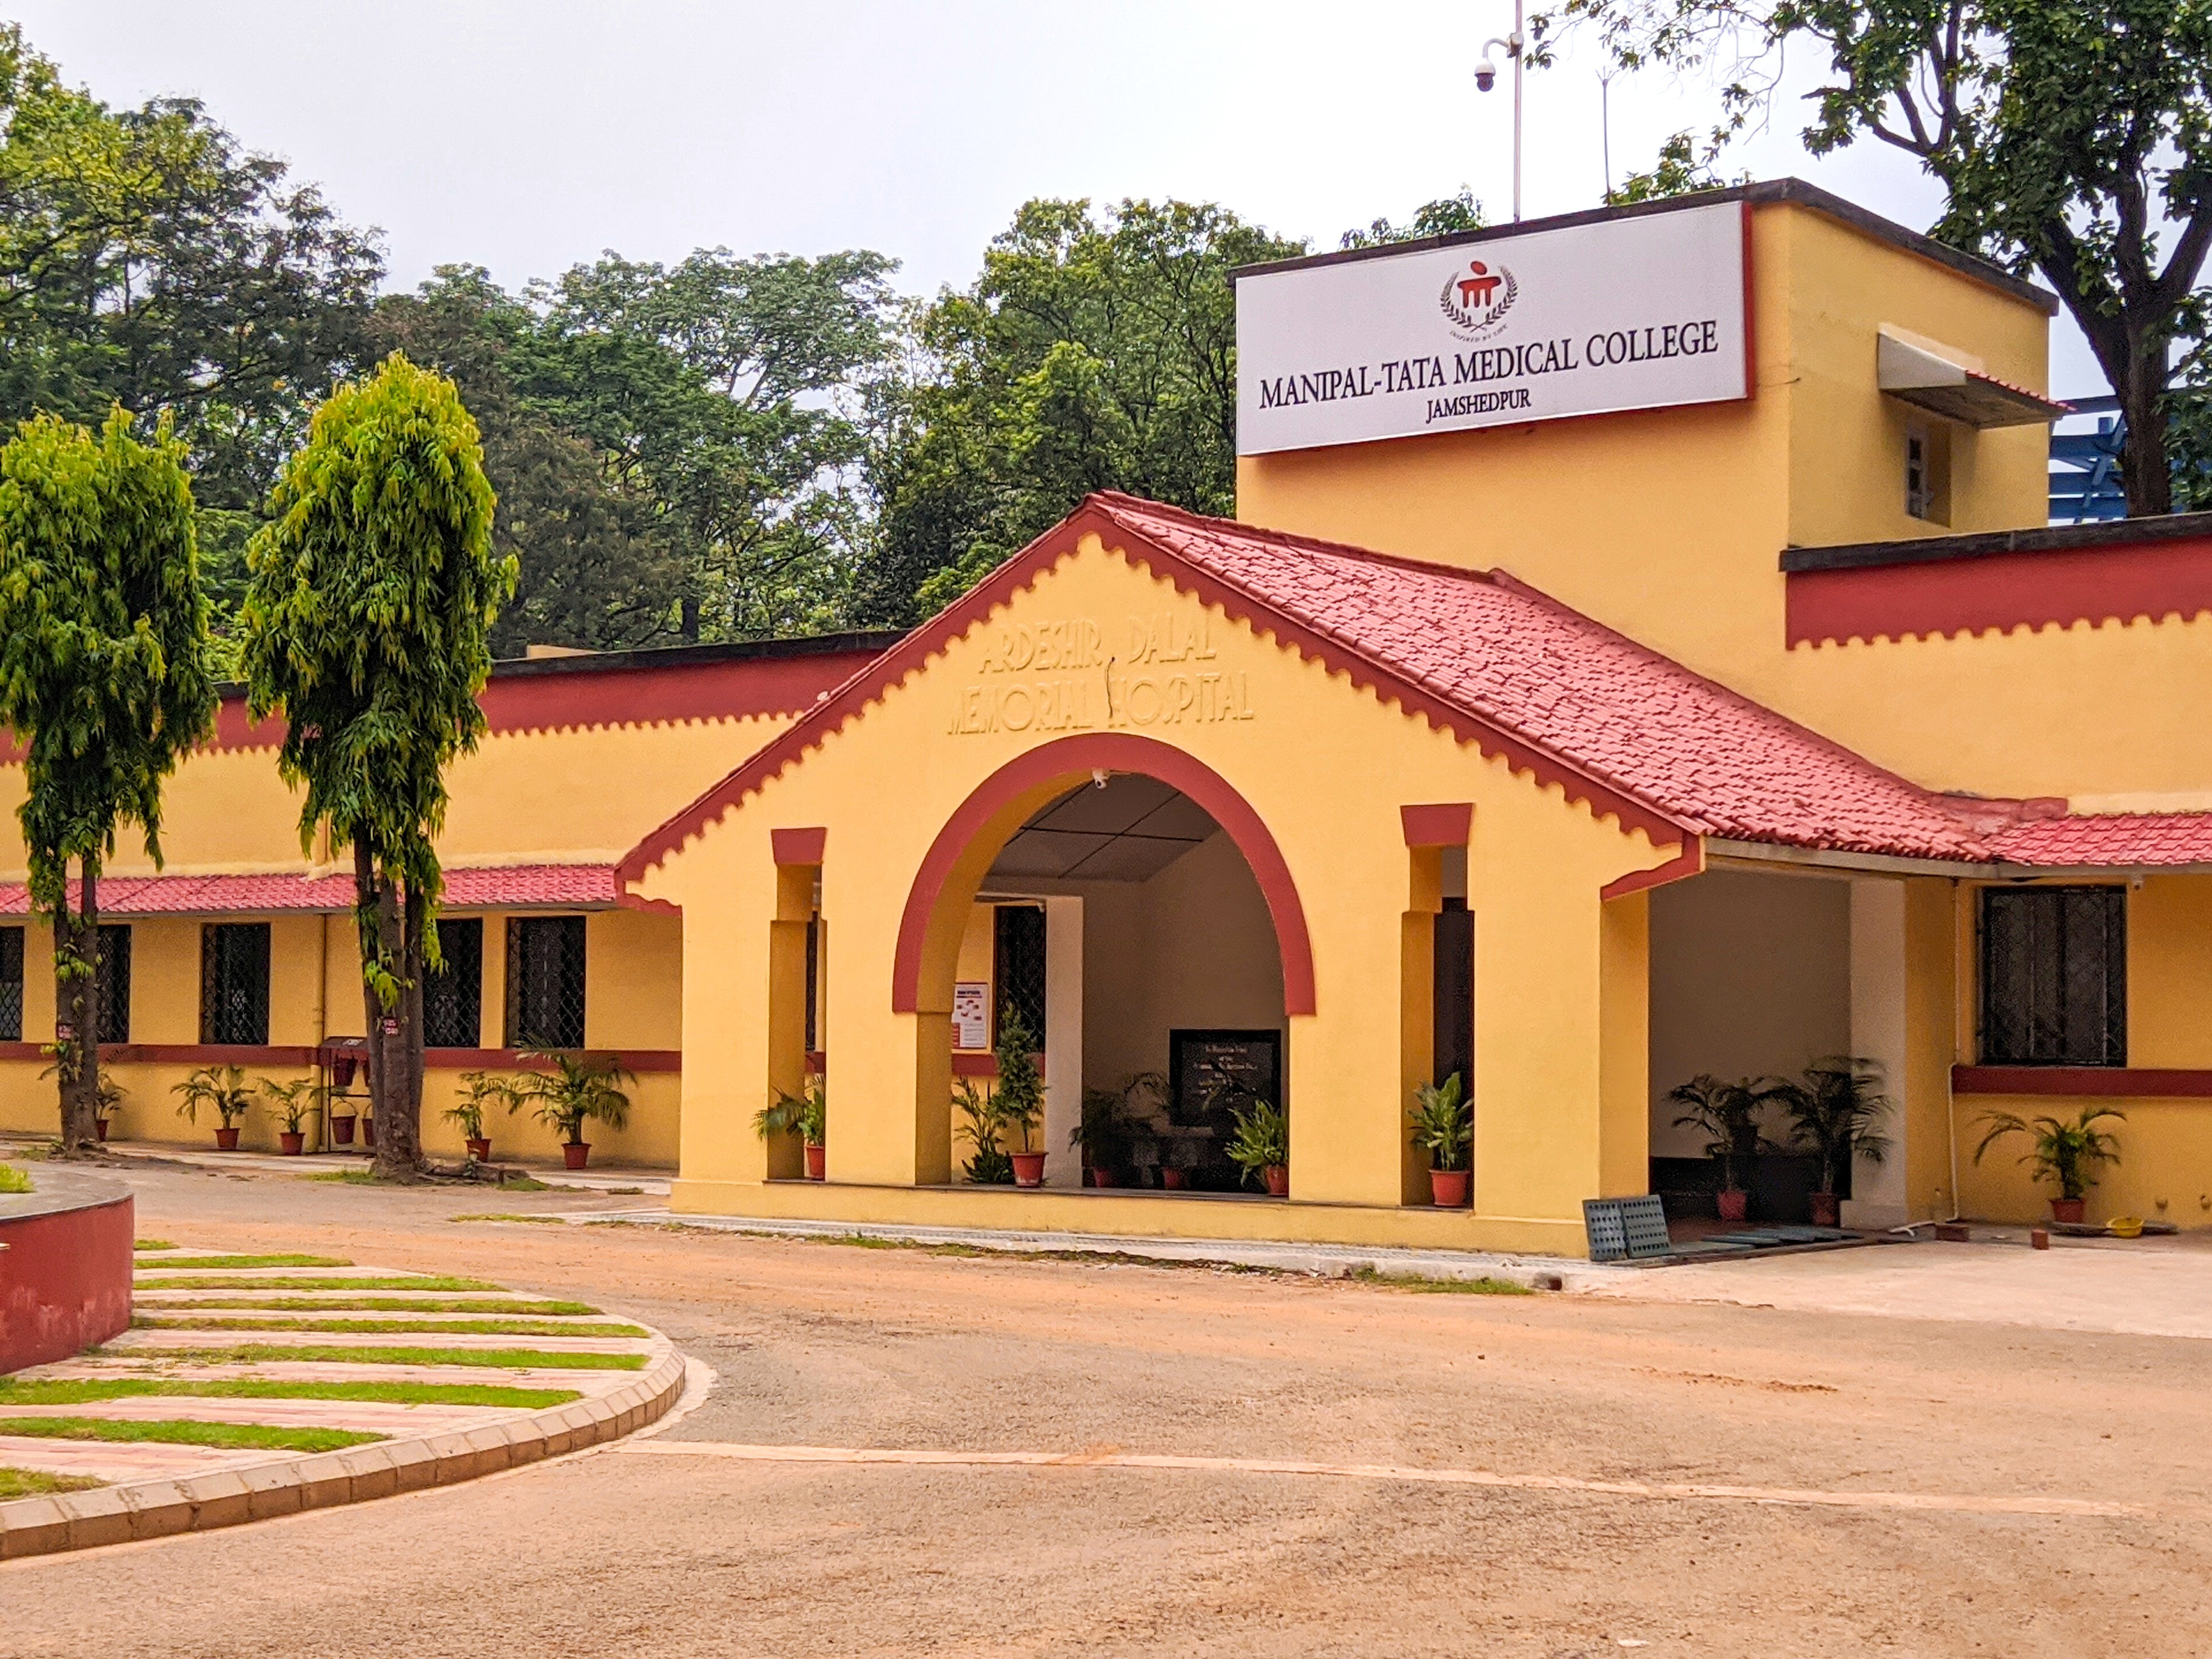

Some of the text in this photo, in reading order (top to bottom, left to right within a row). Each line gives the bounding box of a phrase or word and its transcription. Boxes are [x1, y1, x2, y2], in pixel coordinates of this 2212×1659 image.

[1259, 320, 1719, 409] MANIPAL-TATA MEDICAL COLLEGE
[1426, 389, 1531, 424] JAMSHEDPUR
[978, 612, 1216, 673] ARDESHIR DALAL
